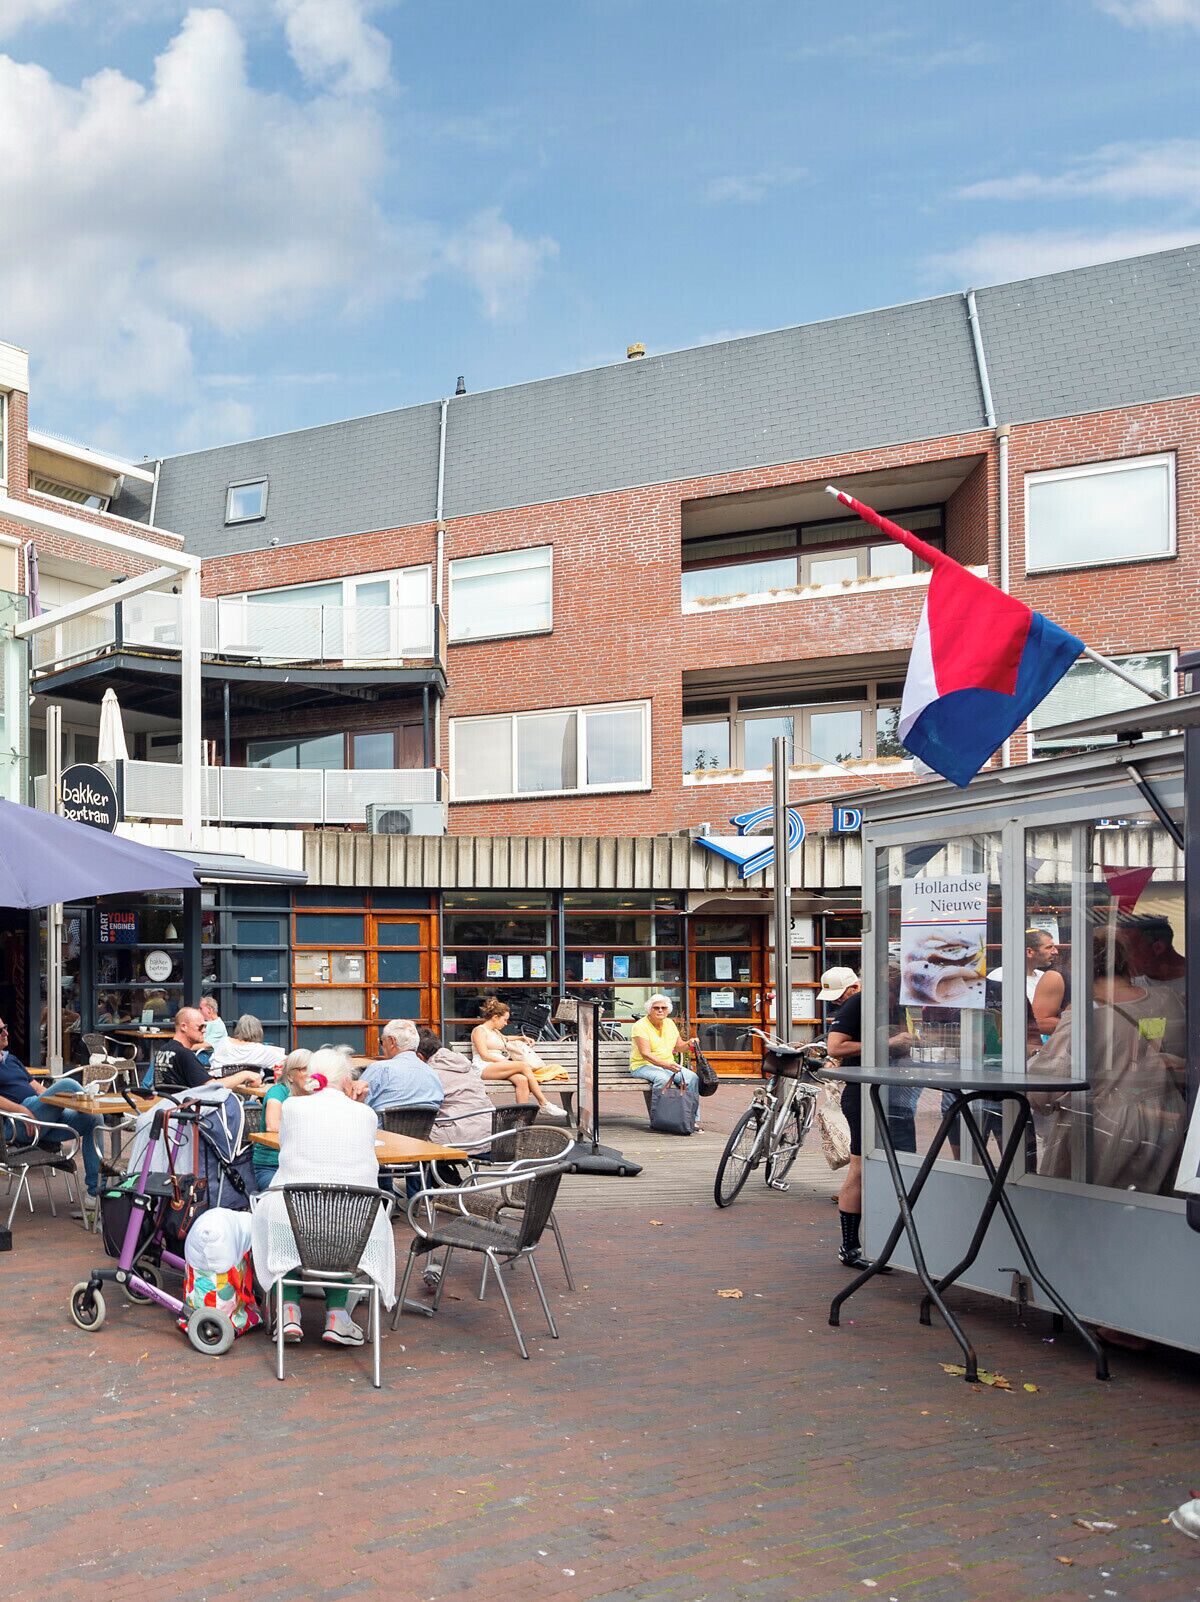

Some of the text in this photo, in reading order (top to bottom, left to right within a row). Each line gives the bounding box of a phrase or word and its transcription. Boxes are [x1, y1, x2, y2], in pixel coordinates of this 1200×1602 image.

[62, 778, 109, 807] bakker
[914, 879, 982, 895] Hollandse
[930, 899, 982, 912] Nieuwe
[108, 911, 135, 923] YOUR
[100, 912, 109, 942] START
